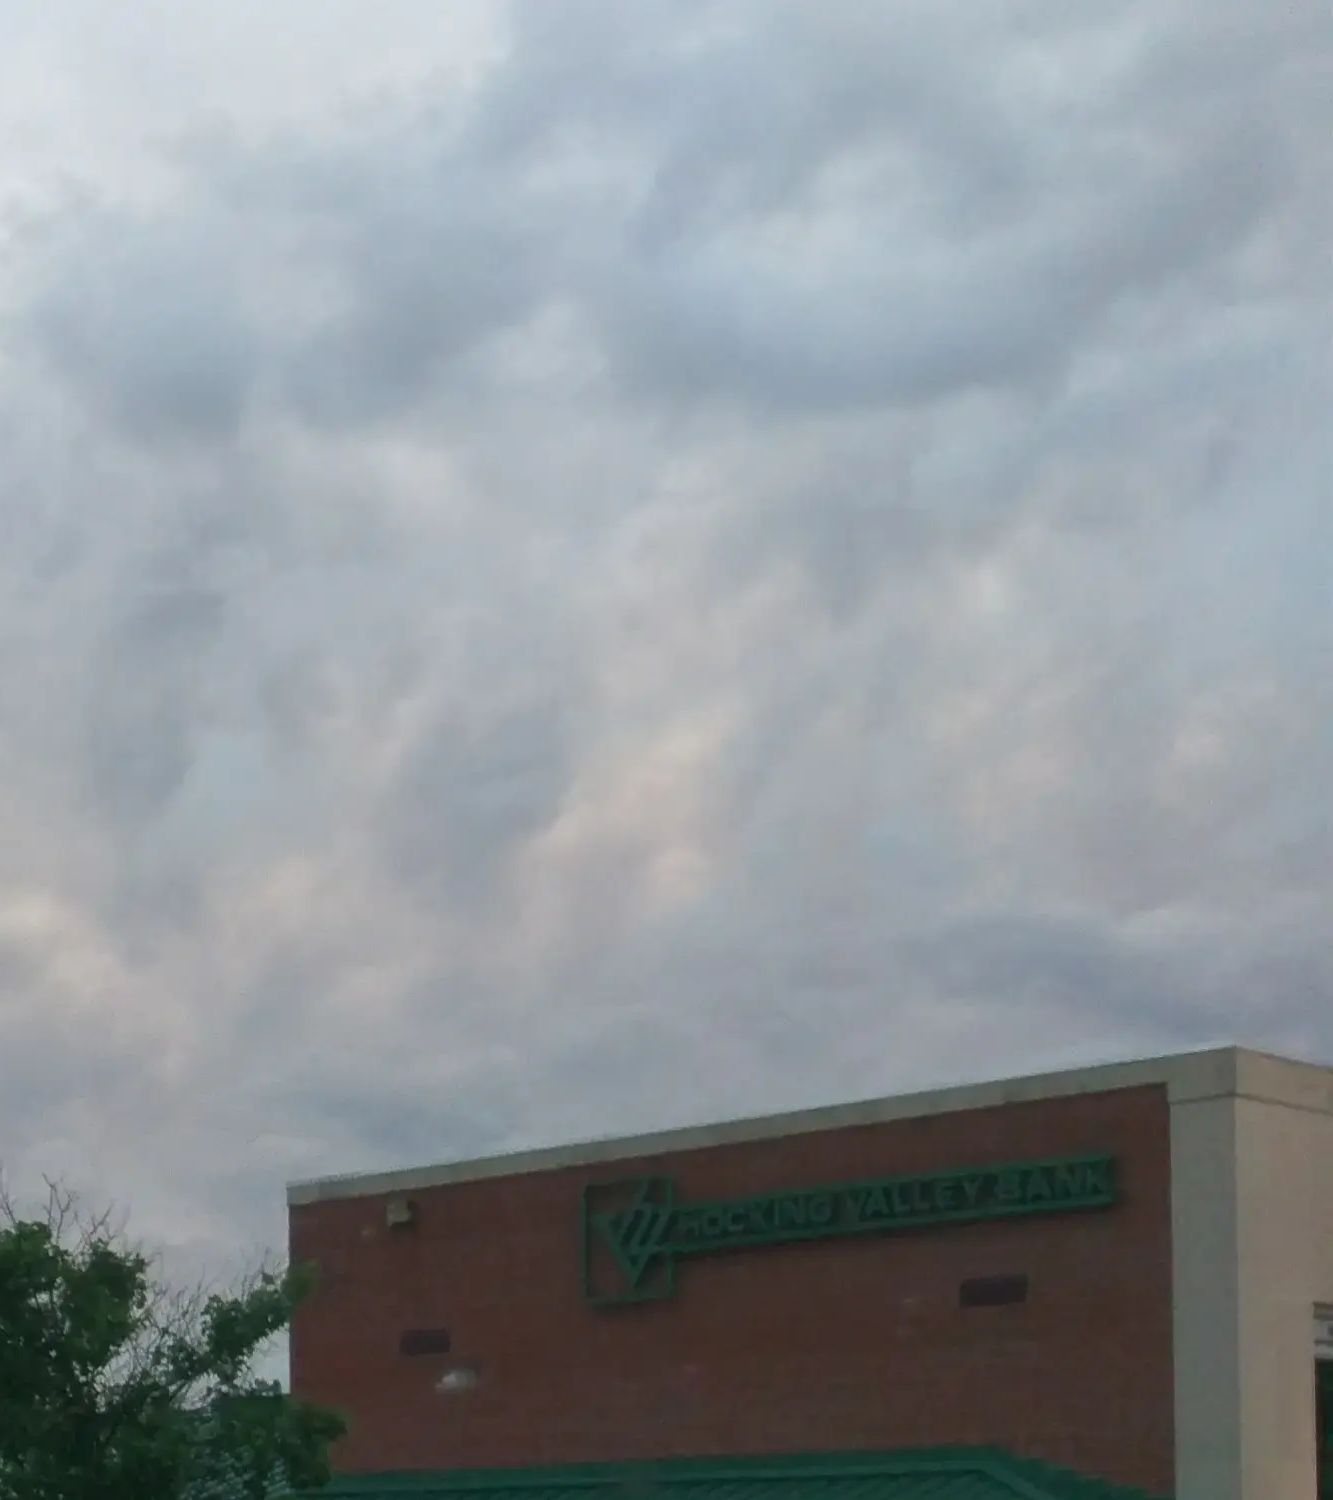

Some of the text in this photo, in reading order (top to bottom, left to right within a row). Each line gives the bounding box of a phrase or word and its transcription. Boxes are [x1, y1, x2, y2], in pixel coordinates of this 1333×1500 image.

[682, 1158, 1113, 1237] HOCKING VALLEY BANK
